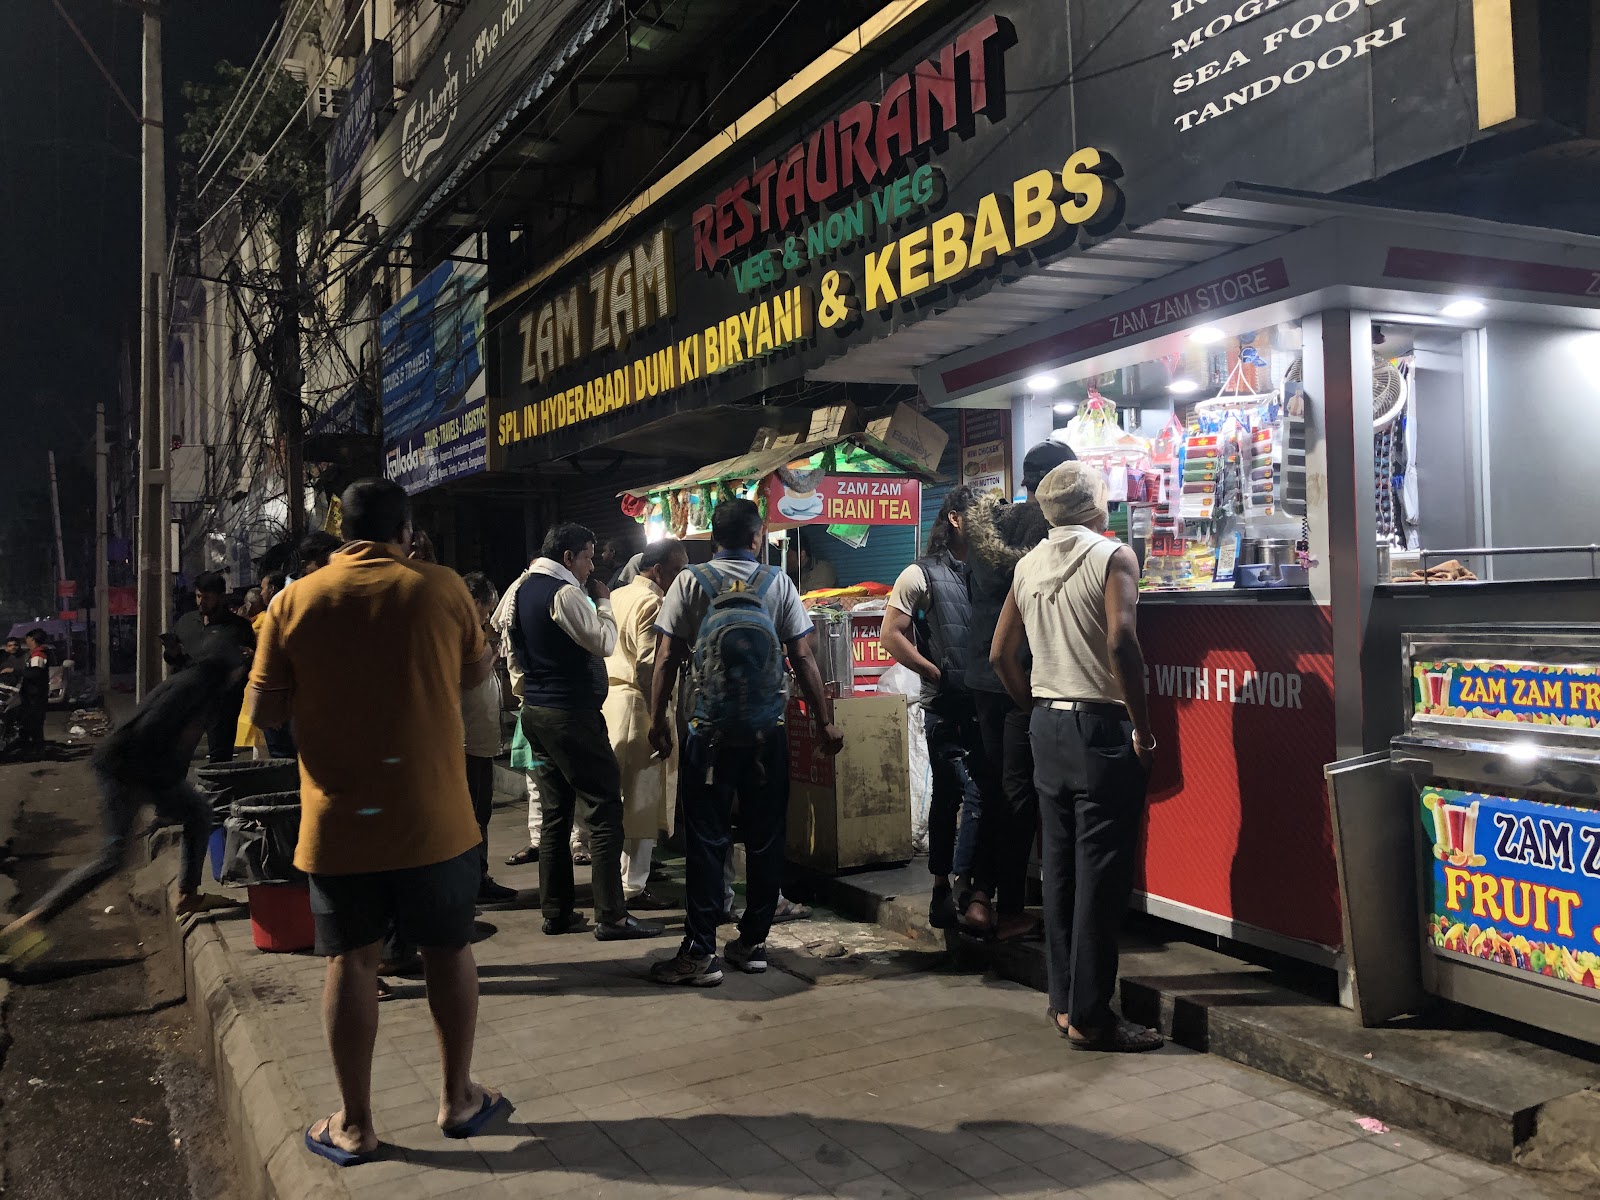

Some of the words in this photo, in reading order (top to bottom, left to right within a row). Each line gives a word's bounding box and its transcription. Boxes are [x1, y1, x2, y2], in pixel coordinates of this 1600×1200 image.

[1172, 49, 1251, 95] SEA
[1262, 0, 1381, 55] FOO
[1173, 17, 1407, 132] TANDOORI
[692, 14, 999, 272] RESTAURANT
[733, 250, 775, 294] VEG
[782, 234, 800, 270] &
[807, 200, 865, 260] NON
[871, 164, 933, 226] VEG
[497, 412, 521, 446] SPL
[523, 403, 538, 439] IN
[541, 368, 630, 433] HYDERABADI
[635, 345, 675, 402] DUM
[678, 333, 700, 385] KI
[705, 285, 805, 375] BIRYANI
[817, 269, 847, 329] &
[864, 147, 1105, 312] KEBABS
[519, 285, 581, 385] ZAM
[589, 228, 669, 353] ZAM
[1109, 308, 1148, 338] ZAM
[1151, 294, 1193, 325] ZAM
[1196, 268, 1270, 310] STORE
[827, 498, 875, 519] IRANI
[877, 500, 912, 520] TEA
[837, 481, 869, 495] ZAM
[871, 483, 902, 496] ZAM
[1155, 664, 1209, 700] WITH
[1215, 668, 1303, 709] FLAVOR
[1459, 675, 1507, 704] ZAM
[1511, 678, 1564, 708] ZAM
[1493, 812, 1576, 874] ZAM
[1443, 865, 1583, 938] FRUIT
